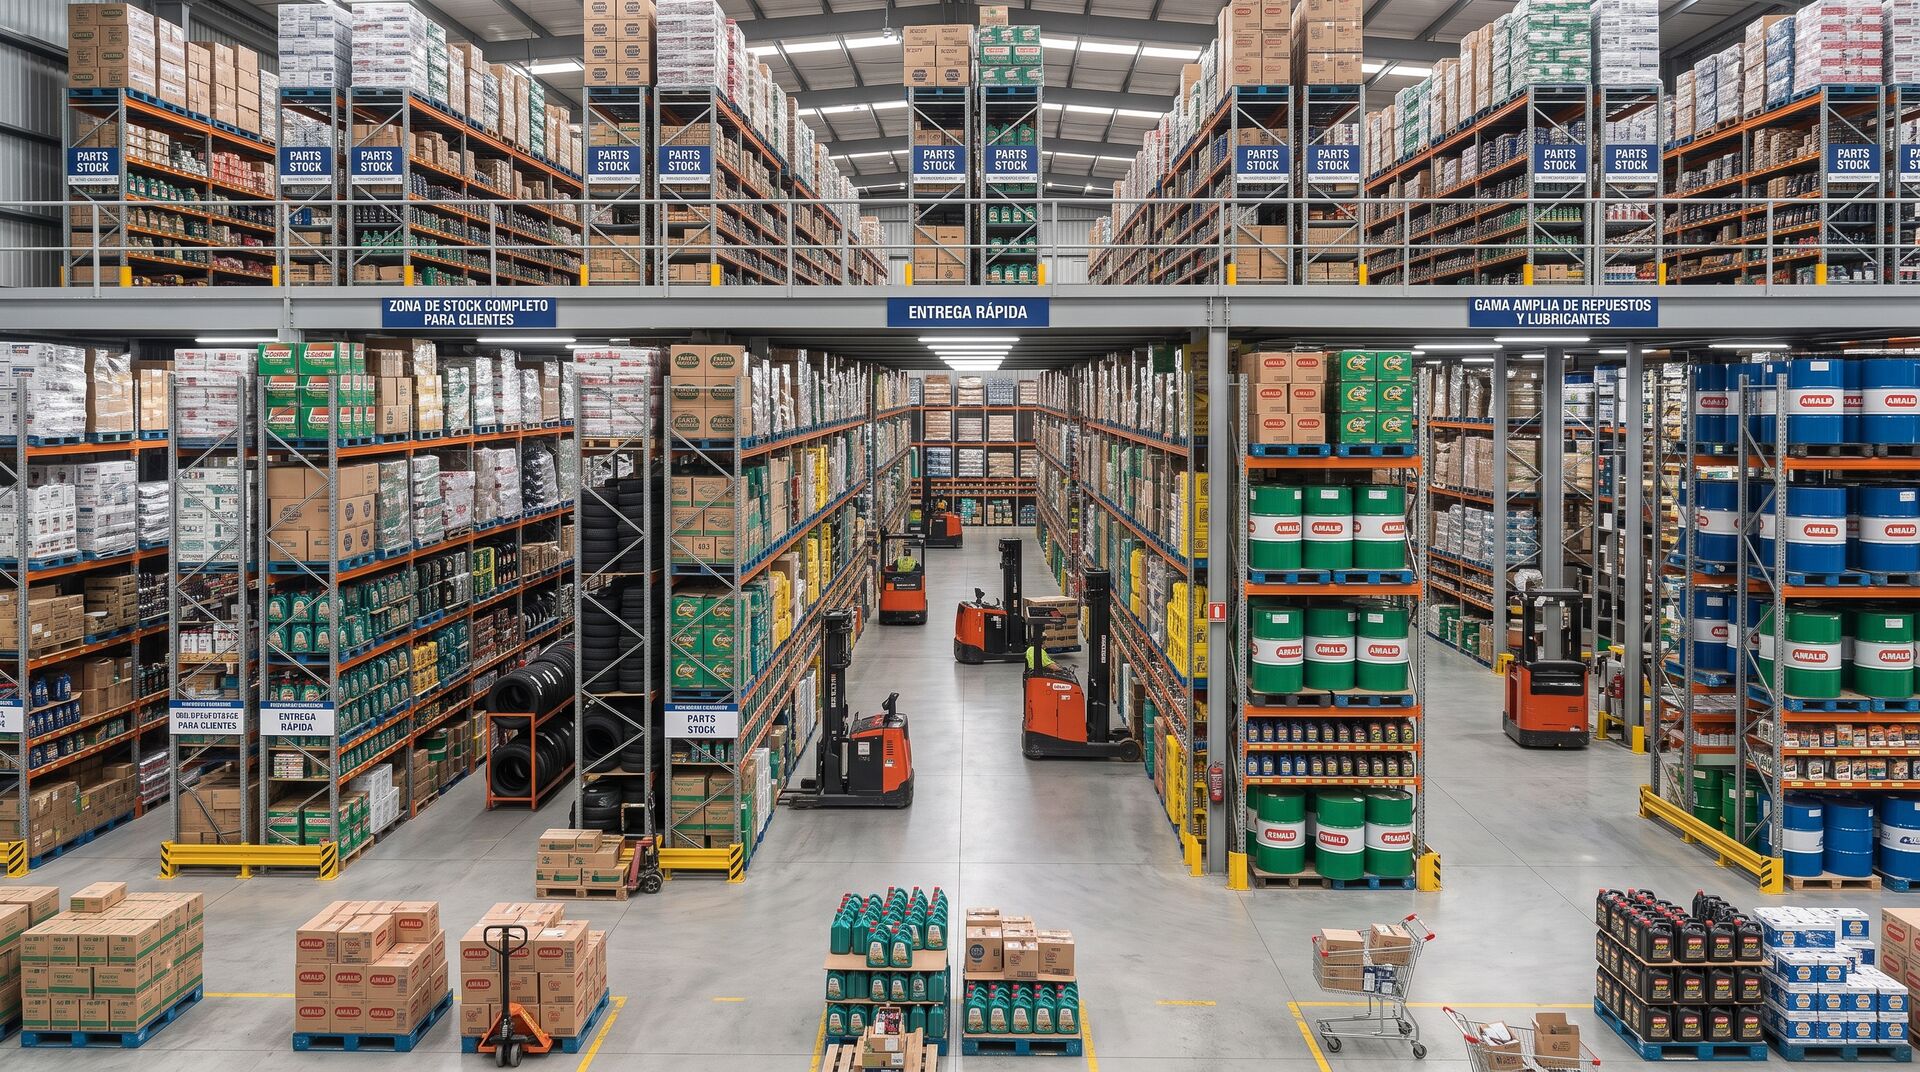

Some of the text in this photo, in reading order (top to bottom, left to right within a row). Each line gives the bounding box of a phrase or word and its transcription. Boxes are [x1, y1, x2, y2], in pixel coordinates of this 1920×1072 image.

[78, 151, 108, 161] PARTS
[290, 151, 321, 160] PARTS
[361, 151, 392, 160] PARTS
[598, 150, 629, 160] PARTS
[669, 150, 700, 160] PARTS
[924, 150, 955, 159] PARTS
[996, 150, 1027, 159] PARTS
[1248, 149, 1278, 159] PARTS
[1318, 149, 1349, 159] PARTS
[1544, 149, 1576, 158] PARTS
[1616, 149, 1647, 158] PARTS
[1838, 149, 1869, 158] PARTS
[77, 163, 109, 172] STOCK
[290, 162, 321, 171] STOCK
[361, 162, 392, 171] STOCK
[598, 162, 630, 171] STOCK
[668, 161, 700, 171] STOCK
[923, 161, 955, 170] STOCK
[995, 161, 1027, 170] STOCK
[1247, 161, 1279, 170] STOCK
[1317, 161, 1349, 170] STOCK
[1544, 160, 1576, 170] STOCK
[1615, 160, 1647, 170] STOCK
[1837, 160, 1870, 169] STOCK
[389, 299, 549, 312] ZONA DE STOCK COMPLETO
[1474, 299, 1652, 311] GAMA AMPLIA DE REPUESTOS
[908, 301, 1028, 319] ENTREGA RÁPIDA
[424, 313, 514, 326] PARA CLIENTES
[1516, 313, 1610, 325] Y LUBRICANTES
[278, 712, 317, 721] ENTREGA
[687, 714, 716, 723] PARTS
[178, 721, 237, 730] PARA CLIENTES
[280, 722, 314, 732] RÁPIDA
[687, 725, 716, 734] STOCK
